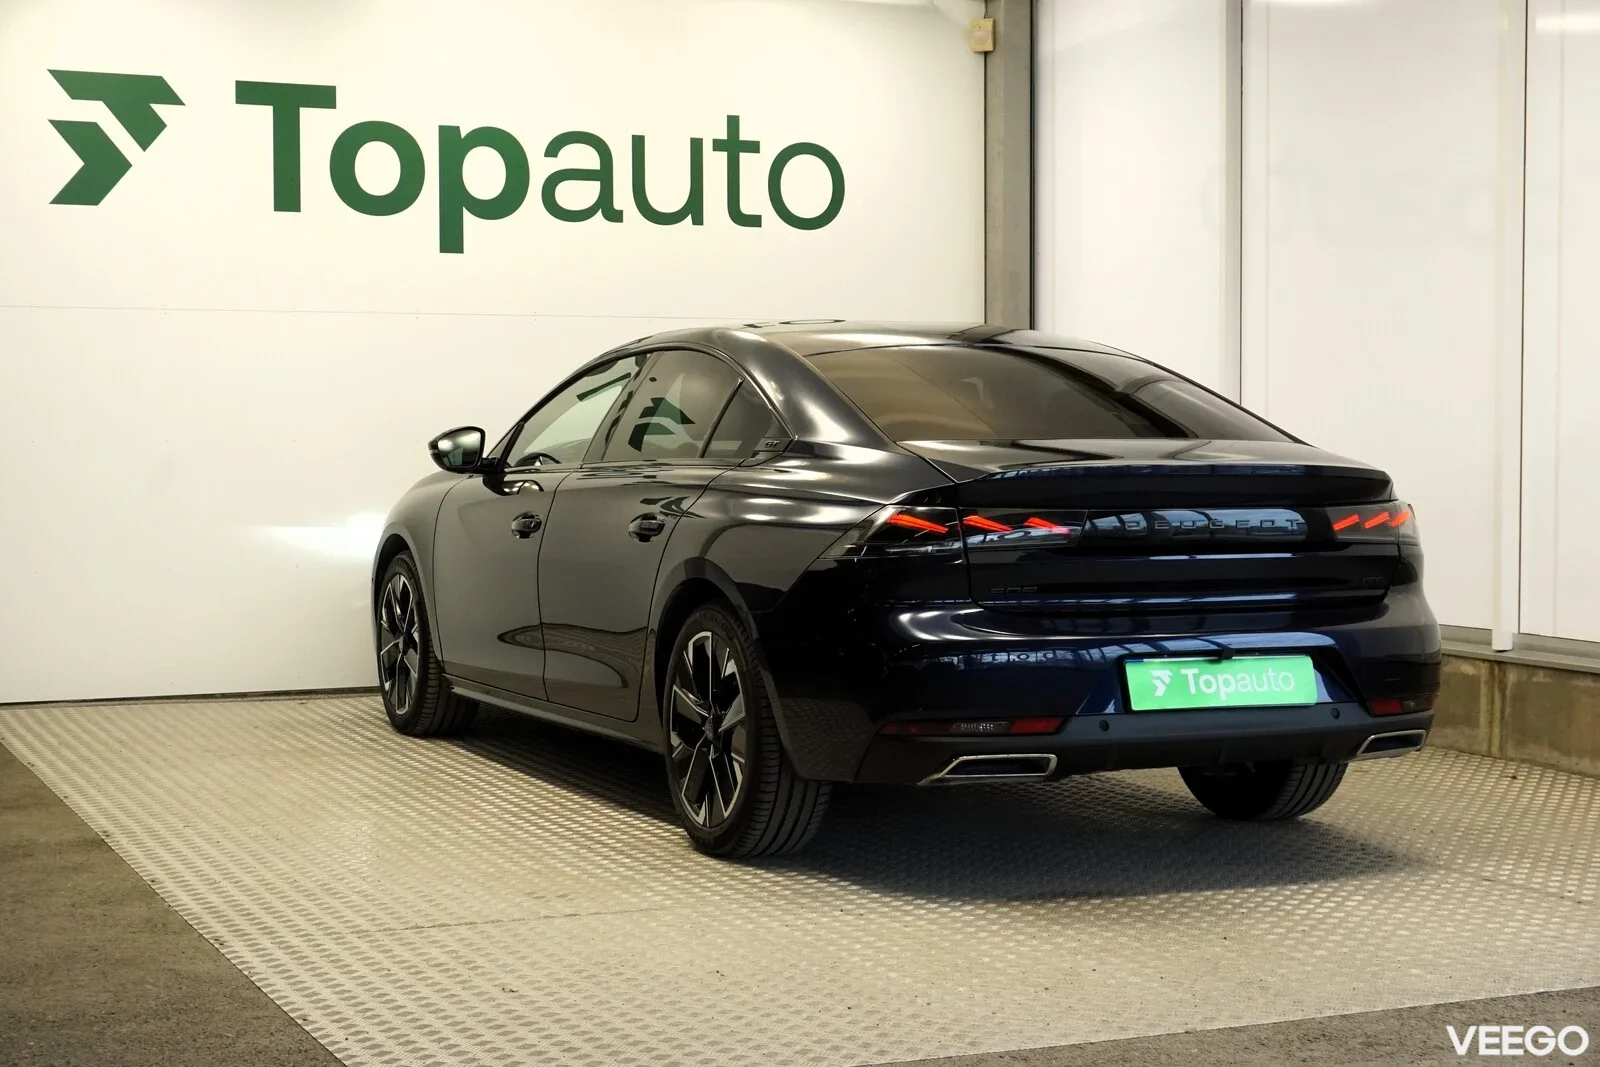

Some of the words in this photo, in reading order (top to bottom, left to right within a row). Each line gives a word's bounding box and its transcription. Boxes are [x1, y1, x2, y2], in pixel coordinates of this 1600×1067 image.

[235, 80, 845, 254] Topauto
[1124, 518, 1306, 531] PEUGEOT
[1180, 667, 1295, 700] Topauto
